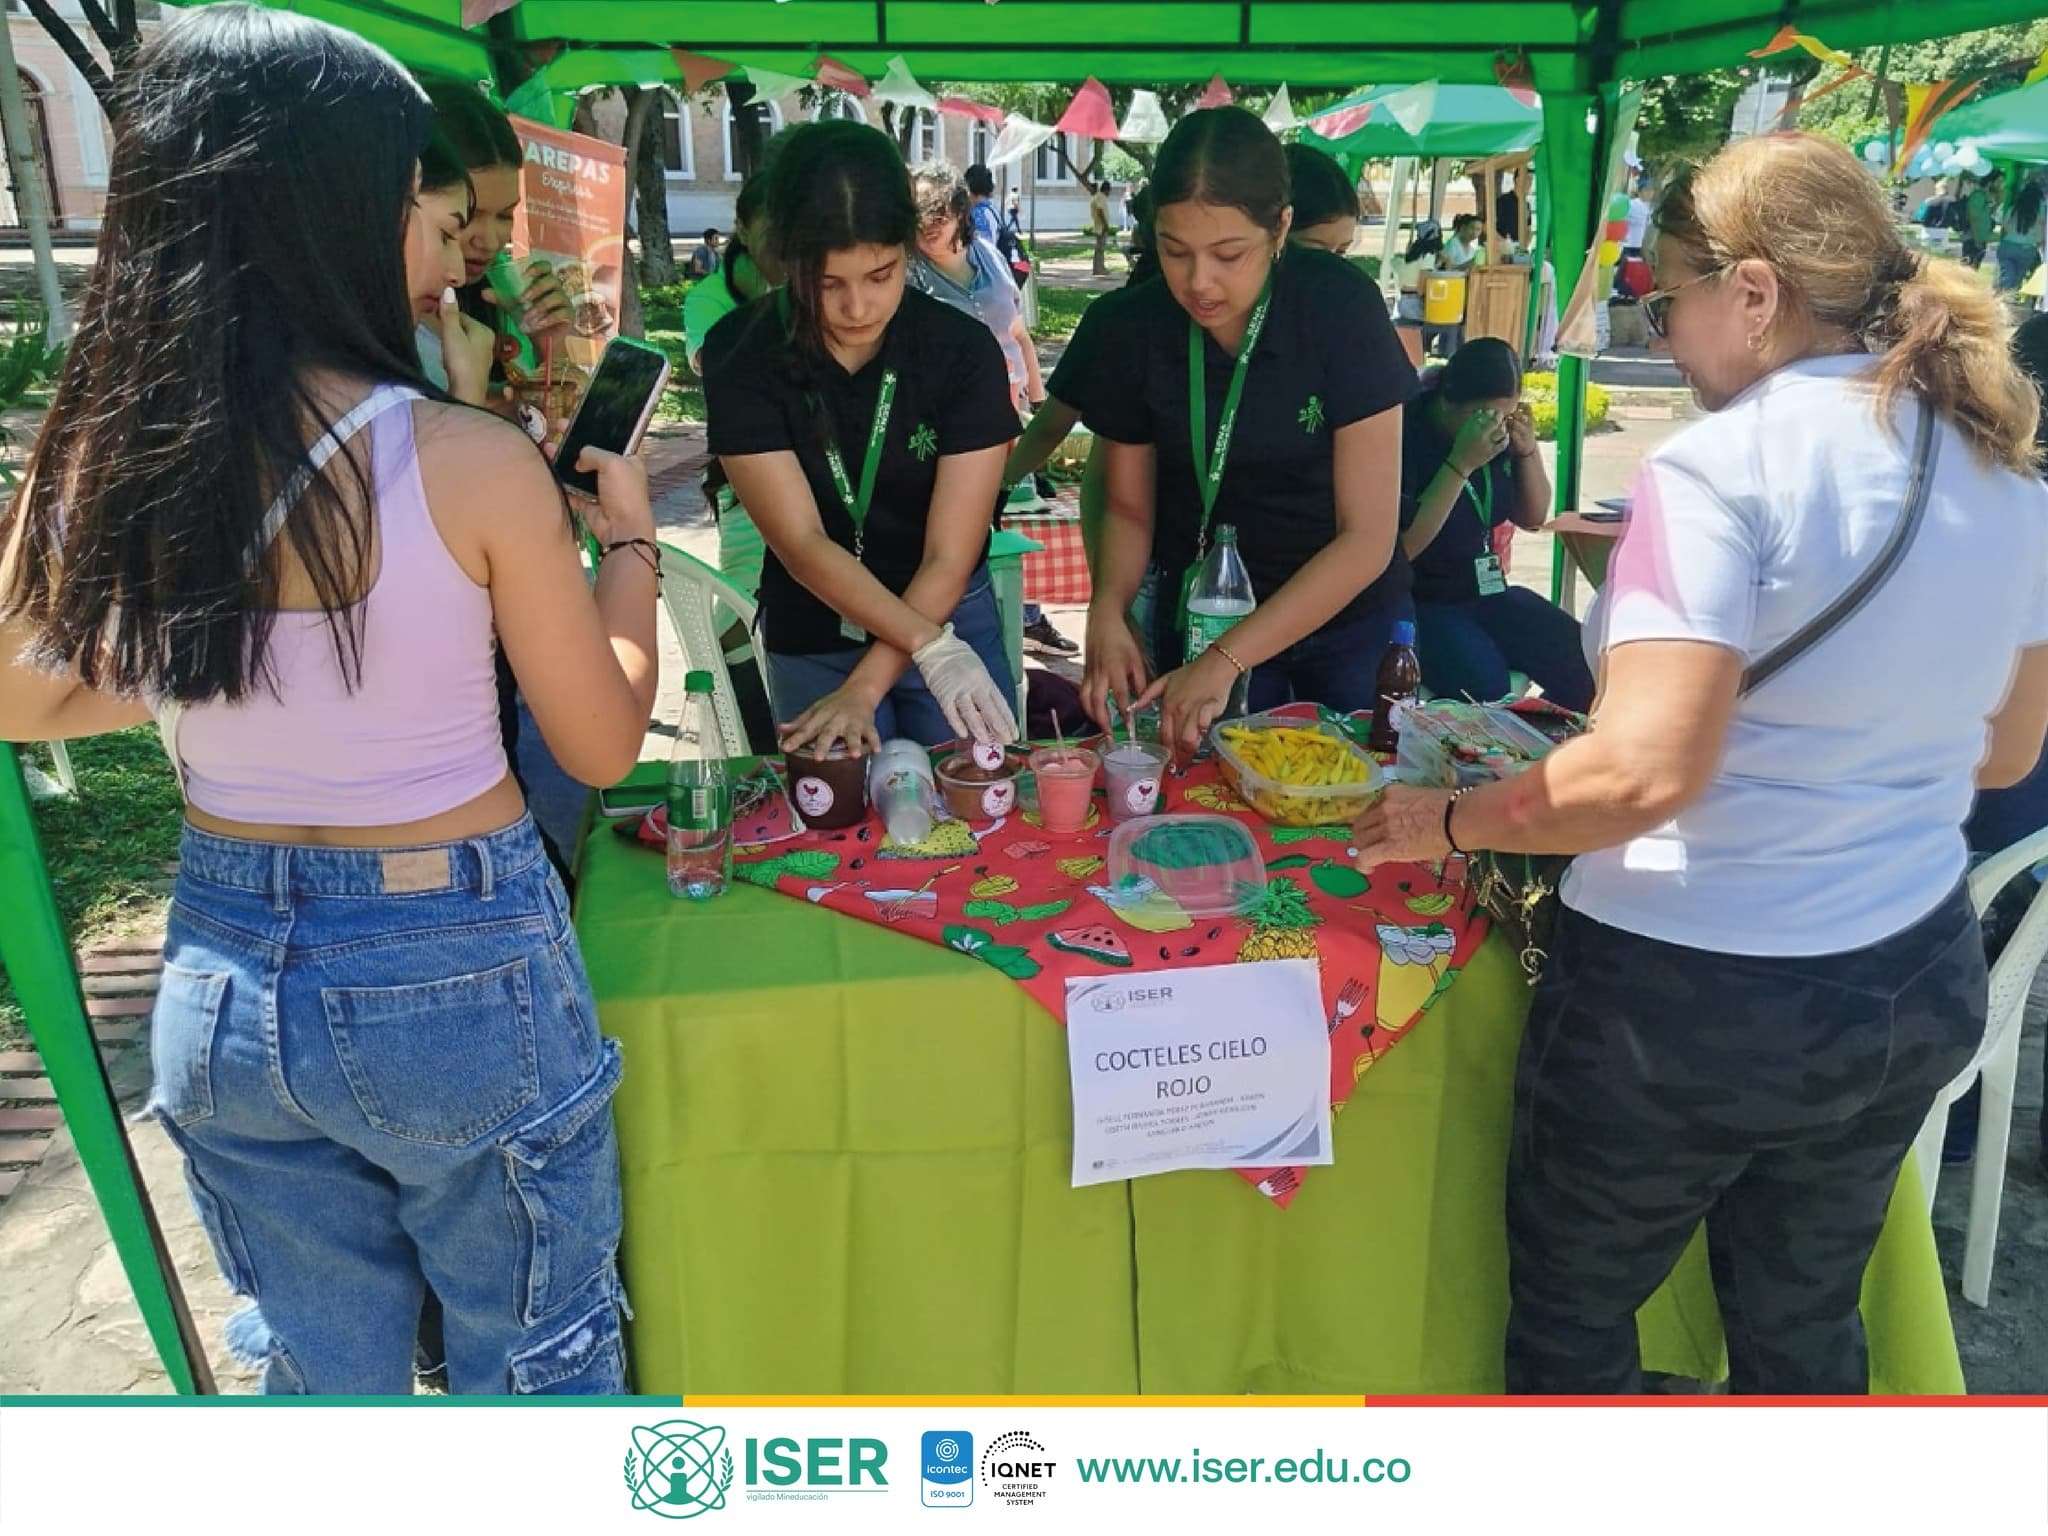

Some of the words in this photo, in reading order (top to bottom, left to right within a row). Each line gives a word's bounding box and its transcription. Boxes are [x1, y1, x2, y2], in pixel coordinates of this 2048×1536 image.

[524, 140, 610, 184] AREPAS
[1128, 987, 1173, 1001] ISER
[1096, 1044, 1202, 1072] COCTELES
[1208, 1036, 1267, 1060] CIELO
[1156, 1075, 1212, 1099] ROJO
